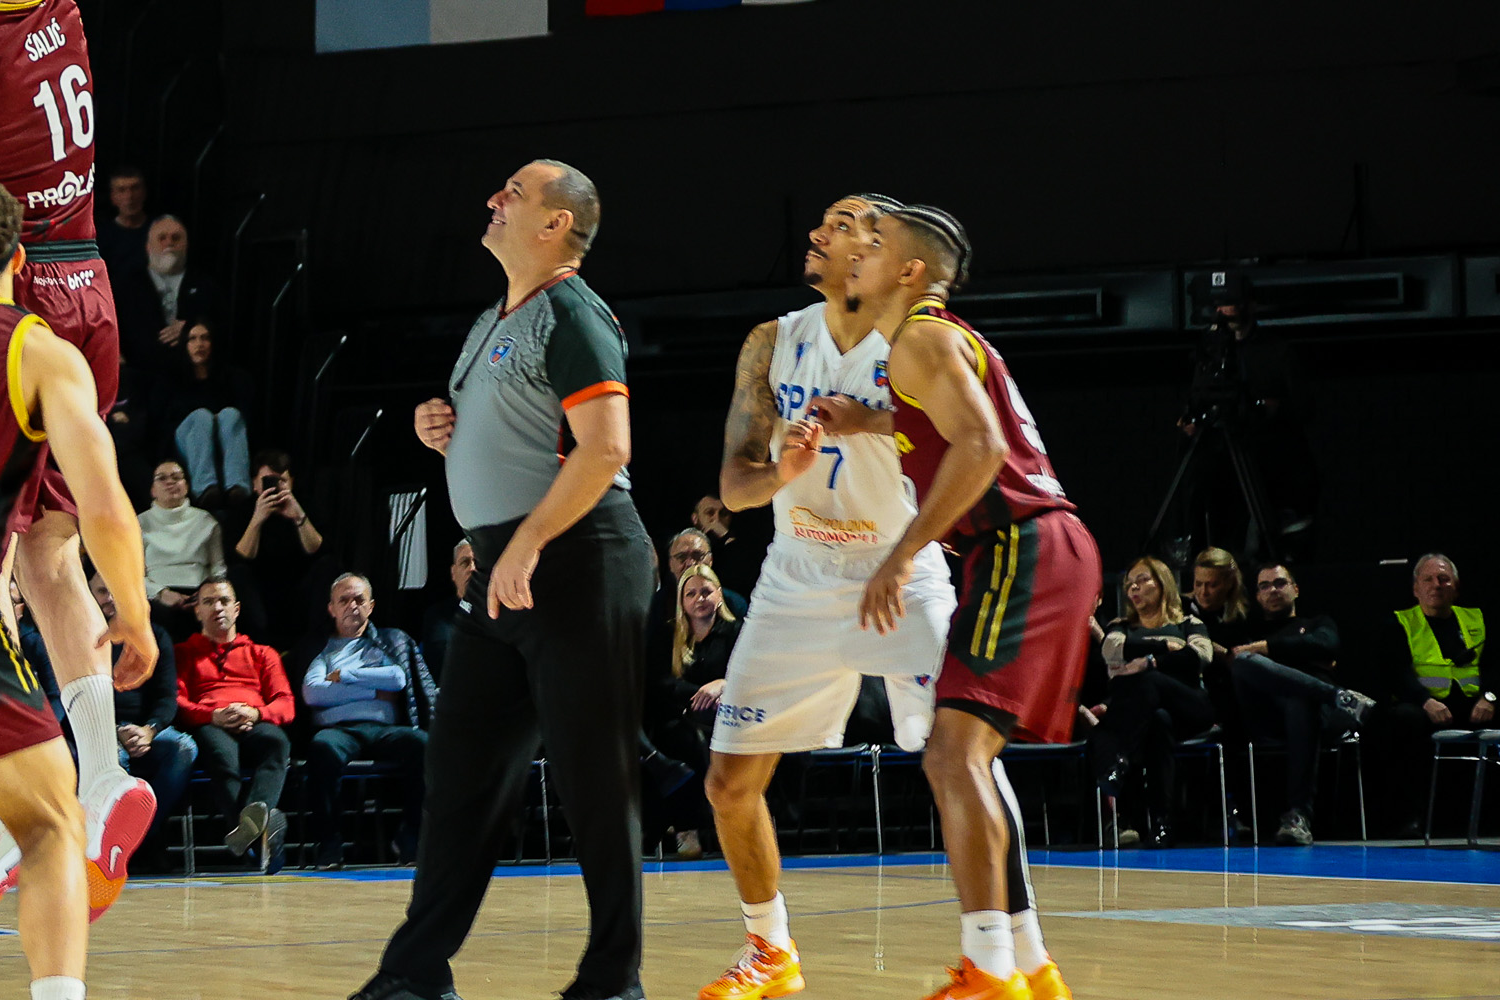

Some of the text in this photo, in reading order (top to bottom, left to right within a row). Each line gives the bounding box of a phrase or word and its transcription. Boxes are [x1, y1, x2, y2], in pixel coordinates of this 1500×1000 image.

[24, 17, 66, 62] ŠALIĆ
[33, 64, 94, 162] 16
[819, 446, 844, 490] 7
